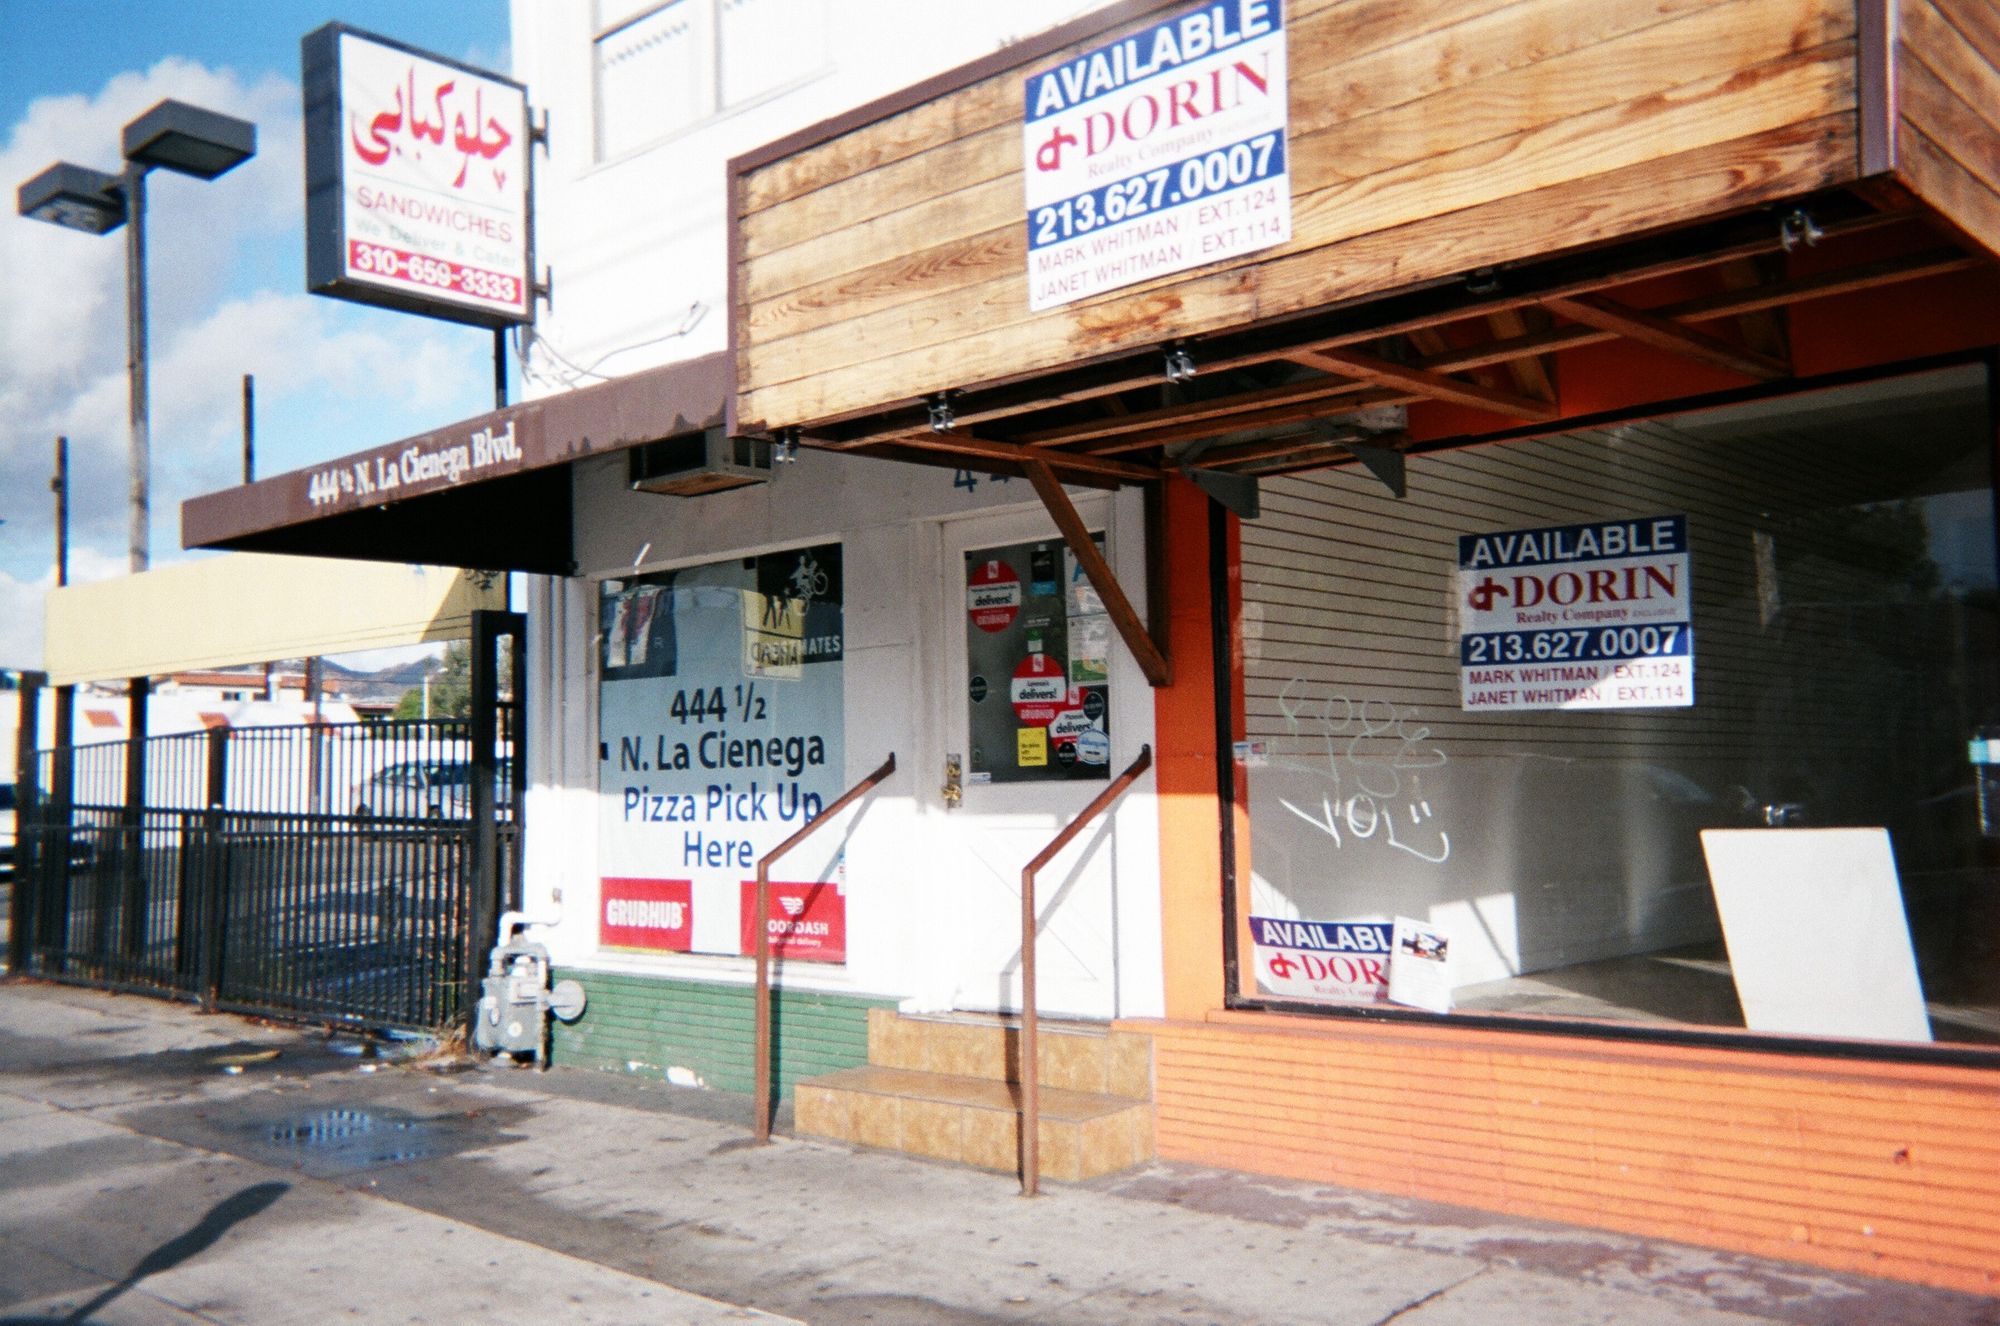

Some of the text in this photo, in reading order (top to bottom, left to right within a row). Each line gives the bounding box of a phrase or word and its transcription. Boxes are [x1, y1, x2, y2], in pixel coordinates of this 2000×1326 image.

[1035, 0, 1271, 116] AVAILABLE
[1082, 49, 1271, 156] DORIN
[1035, 135, 1276, 245] 213.627.0007
[357, 185, 512, 244] SANDWICHES
[1037, 245, 1086, 274] MARK
[1091, 216, 1179, 255] WHITMAN
[356, 243, 516, 301] 310-659-3333
[1038, 271, 1089, 301] JANET
[1095, 244, 1182, 284] WHITMAN
[354, 461, 375, 496] N.
[377, 457, 400, 490] La
[401, 446, 470, 483] Cienega
[472, 421, 523, 467] Blvd.
[1470, 520, 1675, 567] AVAILABLE
[1511, 563, 1679, 608] DORIN
[1516, 611, 1558, 625] Realty
[1563, 608, 1629, 623] Company
[1469, 626, 1680, 662] 213.627.0007
[1469, 670, 1515, 685] MARK
[1520, 666, 1599, 683] WHITMAN
[1469, 690, 1518, 705] JANET
[1524, 687, 1601, 703] WHITMAN
[670, 687, 727, 725] 444
[621, 731, 825, 777] N. La Cienega
[624, 782, 823, 825] Pizza Pick Up
[683, 831, 754, 868] Here
[607, 899, 684, 930] GRUBHUB
[768, 919, 829, 936] OORDASH
[1262, 920, 1391, 952] AVAILABL
[1299, 954, 1390, 987] DOR
